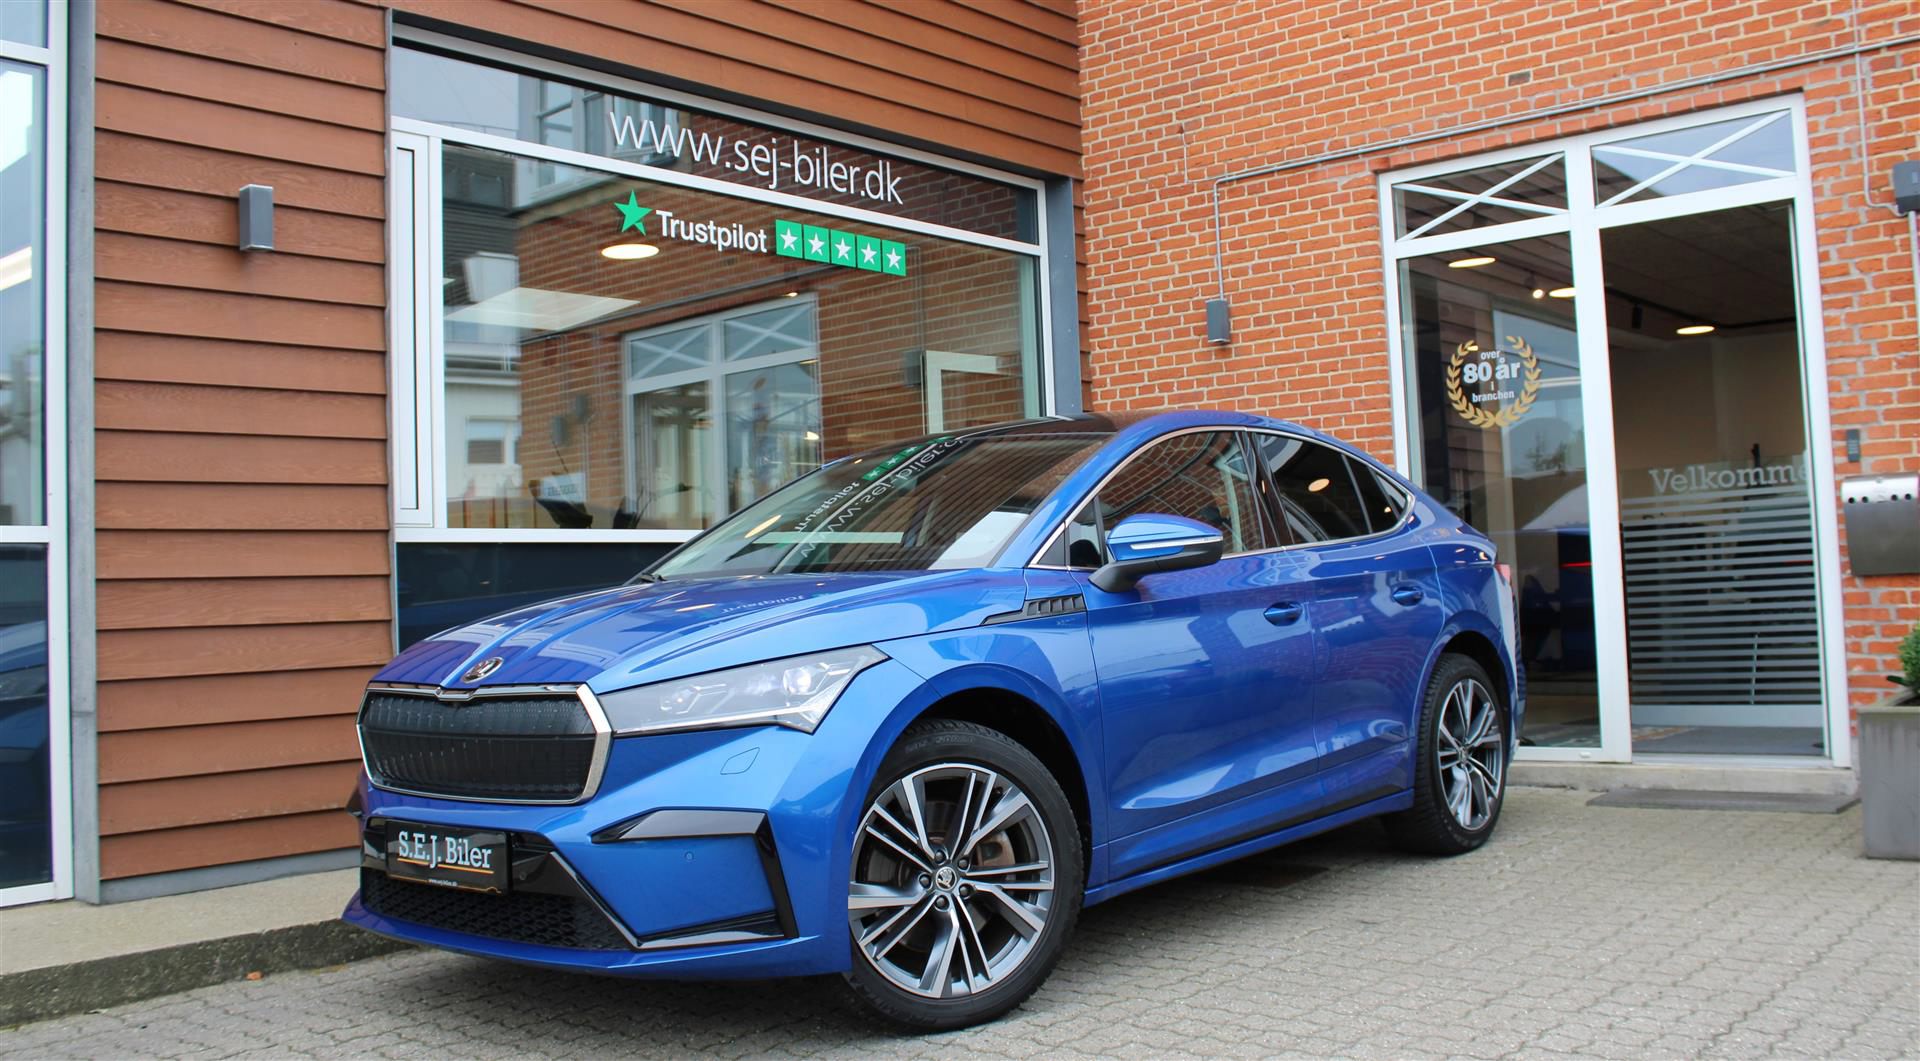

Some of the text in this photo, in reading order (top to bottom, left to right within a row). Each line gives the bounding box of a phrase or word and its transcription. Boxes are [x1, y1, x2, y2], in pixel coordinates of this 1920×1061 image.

[609, 111, 904, 205] www.sej-biler.dk
[655, 209, 768, 253] Trustpilot
[1463, 356, 1521, 384] 80 år
[1480, 350, 1500, 361] over
[1472, 390, 1515, 403] branchen
[398, 830, 493, 868] S.E.J. Biler
